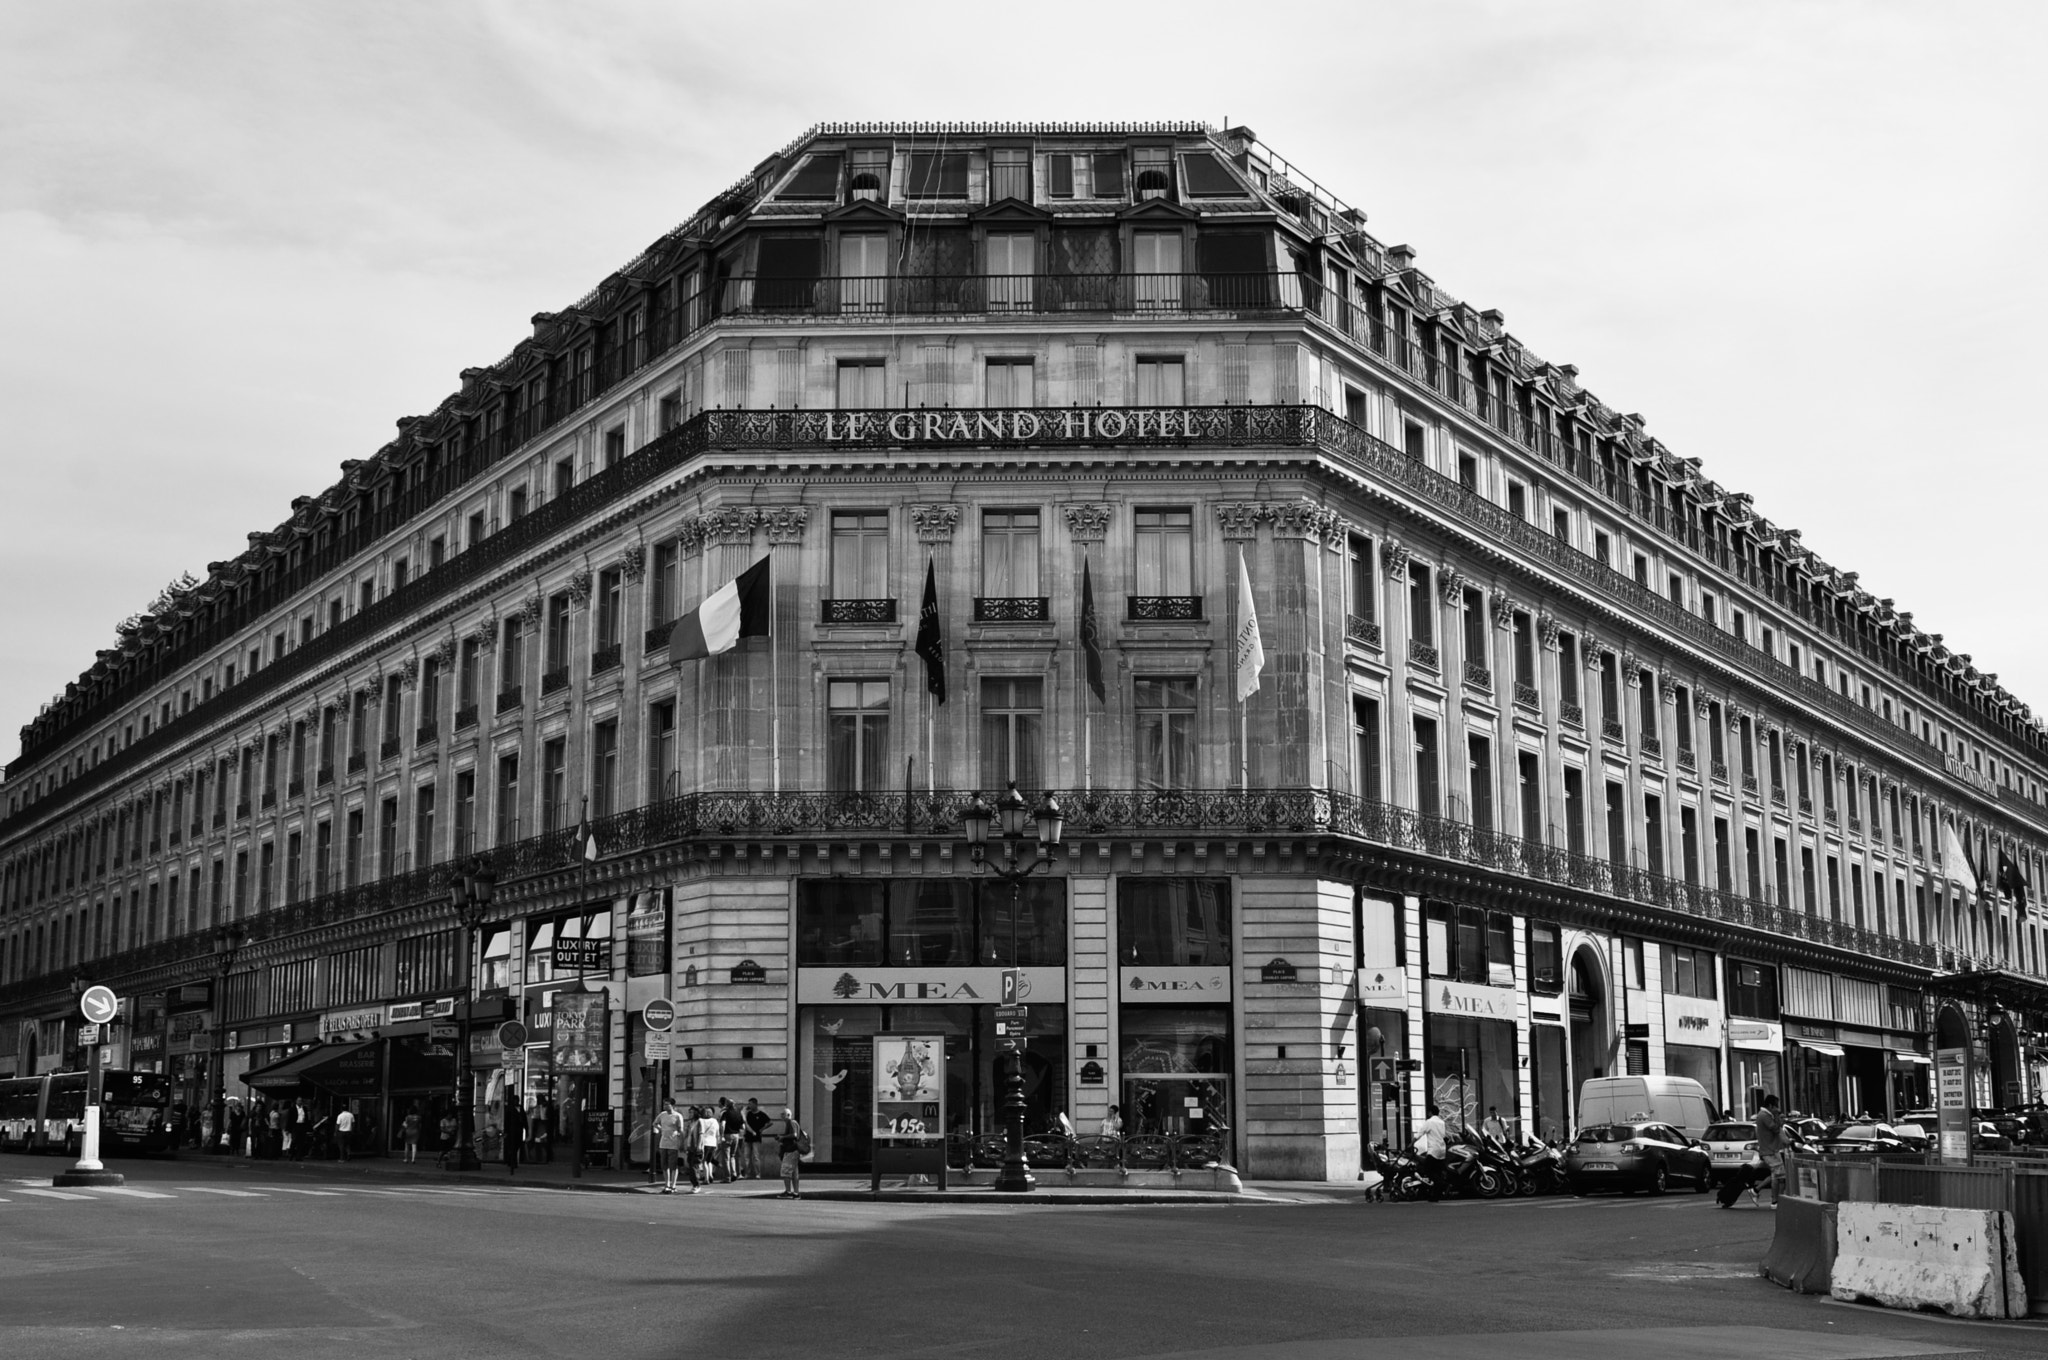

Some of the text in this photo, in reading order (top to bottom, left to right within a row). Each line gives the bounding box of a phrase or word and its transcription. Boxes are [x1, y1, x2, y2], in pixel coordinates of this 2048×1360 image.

[826, 410, 1201, 440] LE GRAND HOTEL
[556, 951, 597, 962] OUTET
[865, 982, 984, 999] MEA
[1005, 976, 1013, 999] P
[1146, 981, 1204, 990] MEA
[1454, 995, 1495, 1014] MEA
[557, 1011, 587, 1020] TOKYO
[556, 1018, 586, 1029] PARK
[357, 1051, 375, 1059] BAR
[132, 1075, 143, 1084] 95
